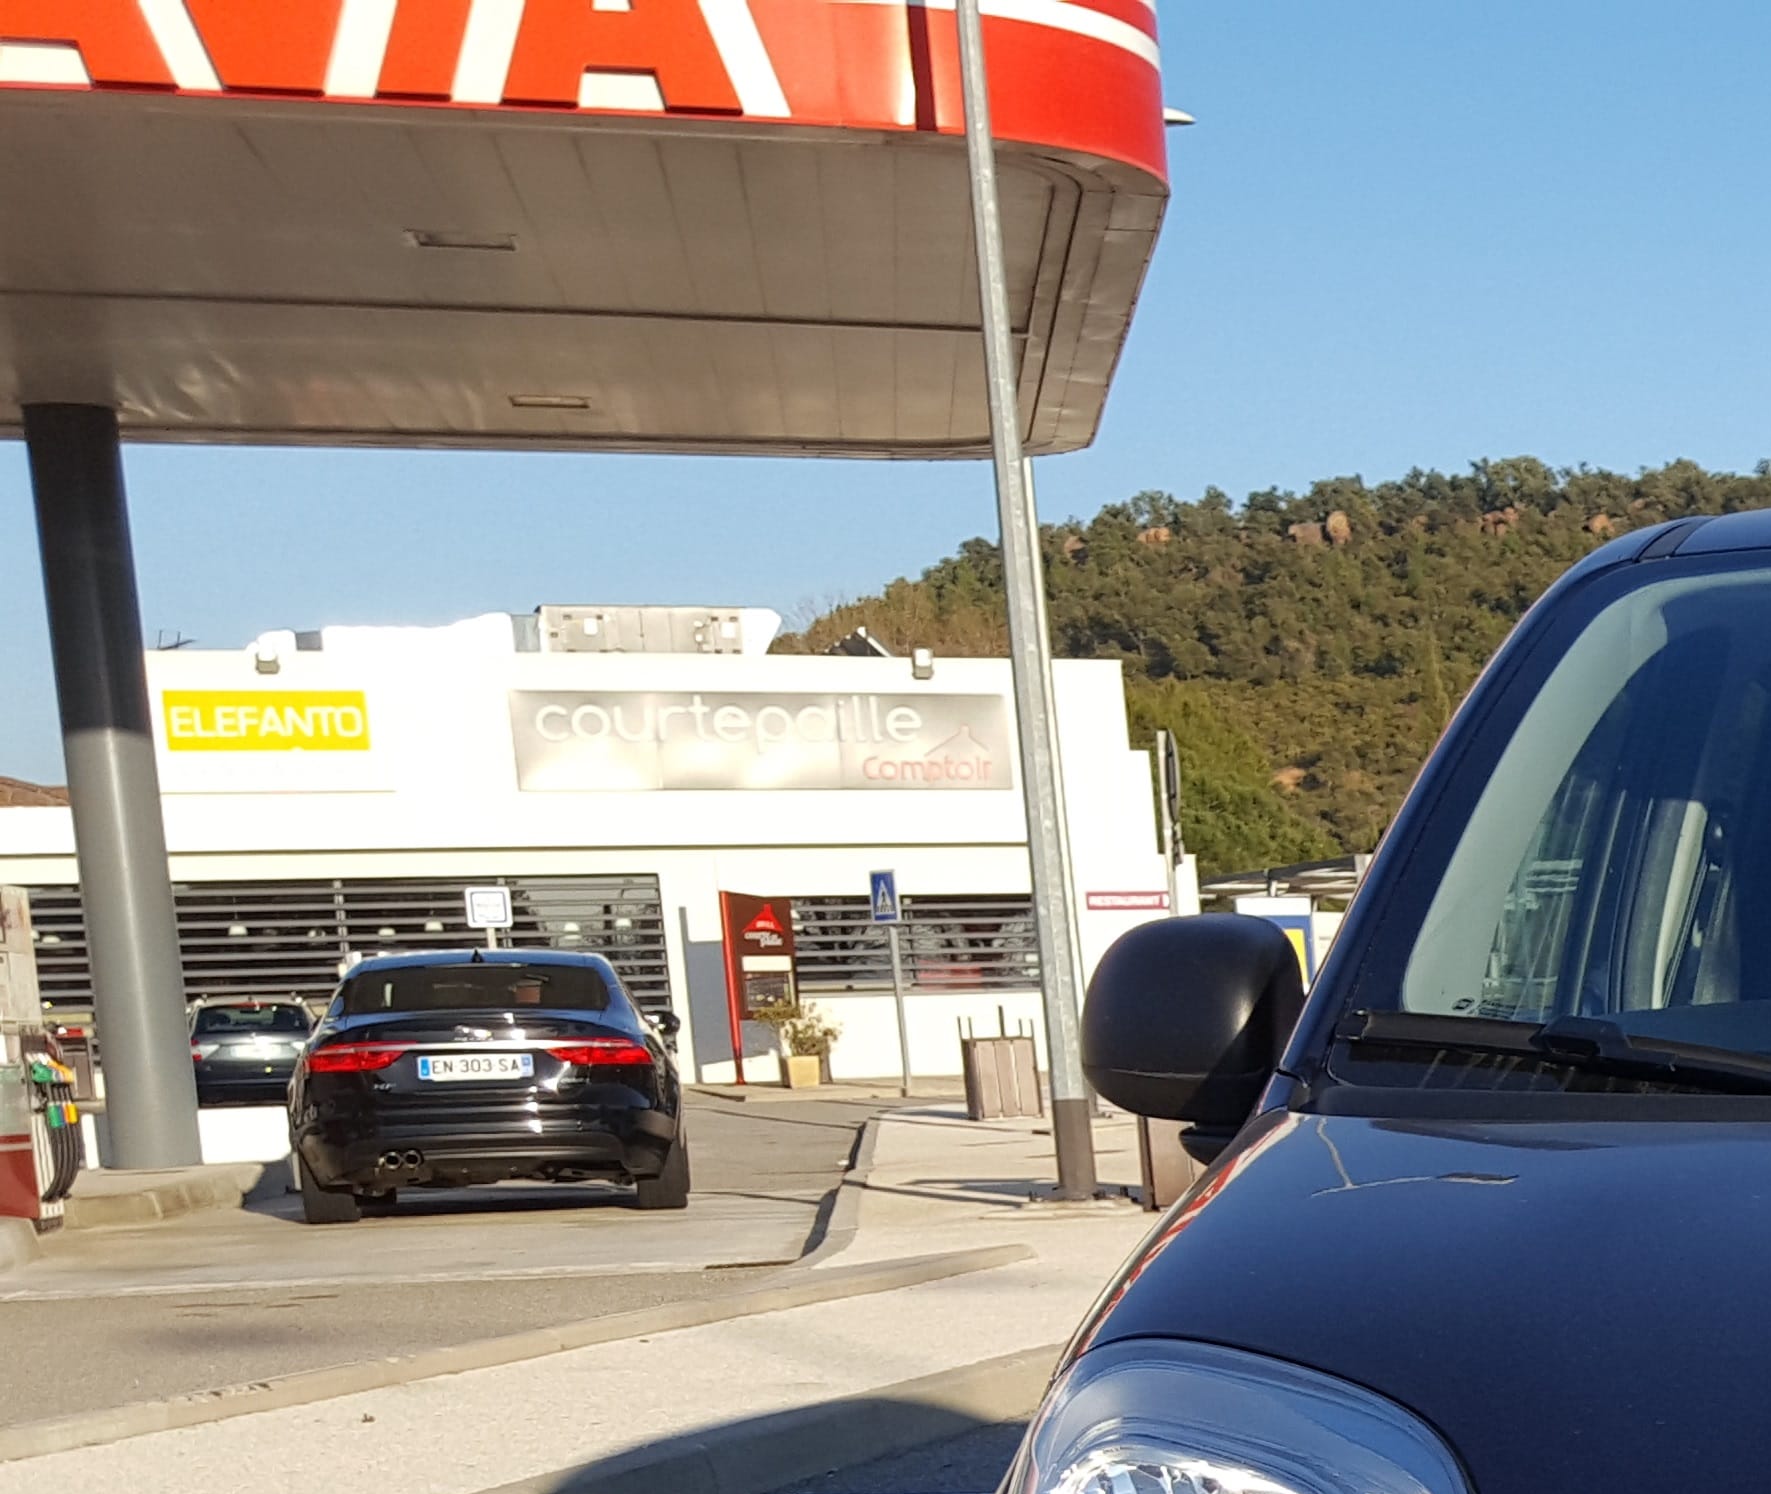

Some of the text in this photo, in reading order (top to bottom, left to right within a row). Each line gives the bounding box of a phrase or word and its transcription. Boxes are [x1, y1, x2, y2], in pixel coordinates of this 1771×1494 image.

[168, 705, 364, 739] ELEFANTO
[534, 694, 923, 756] courtepaille
[862, 754, 993, 783] Comptoir
